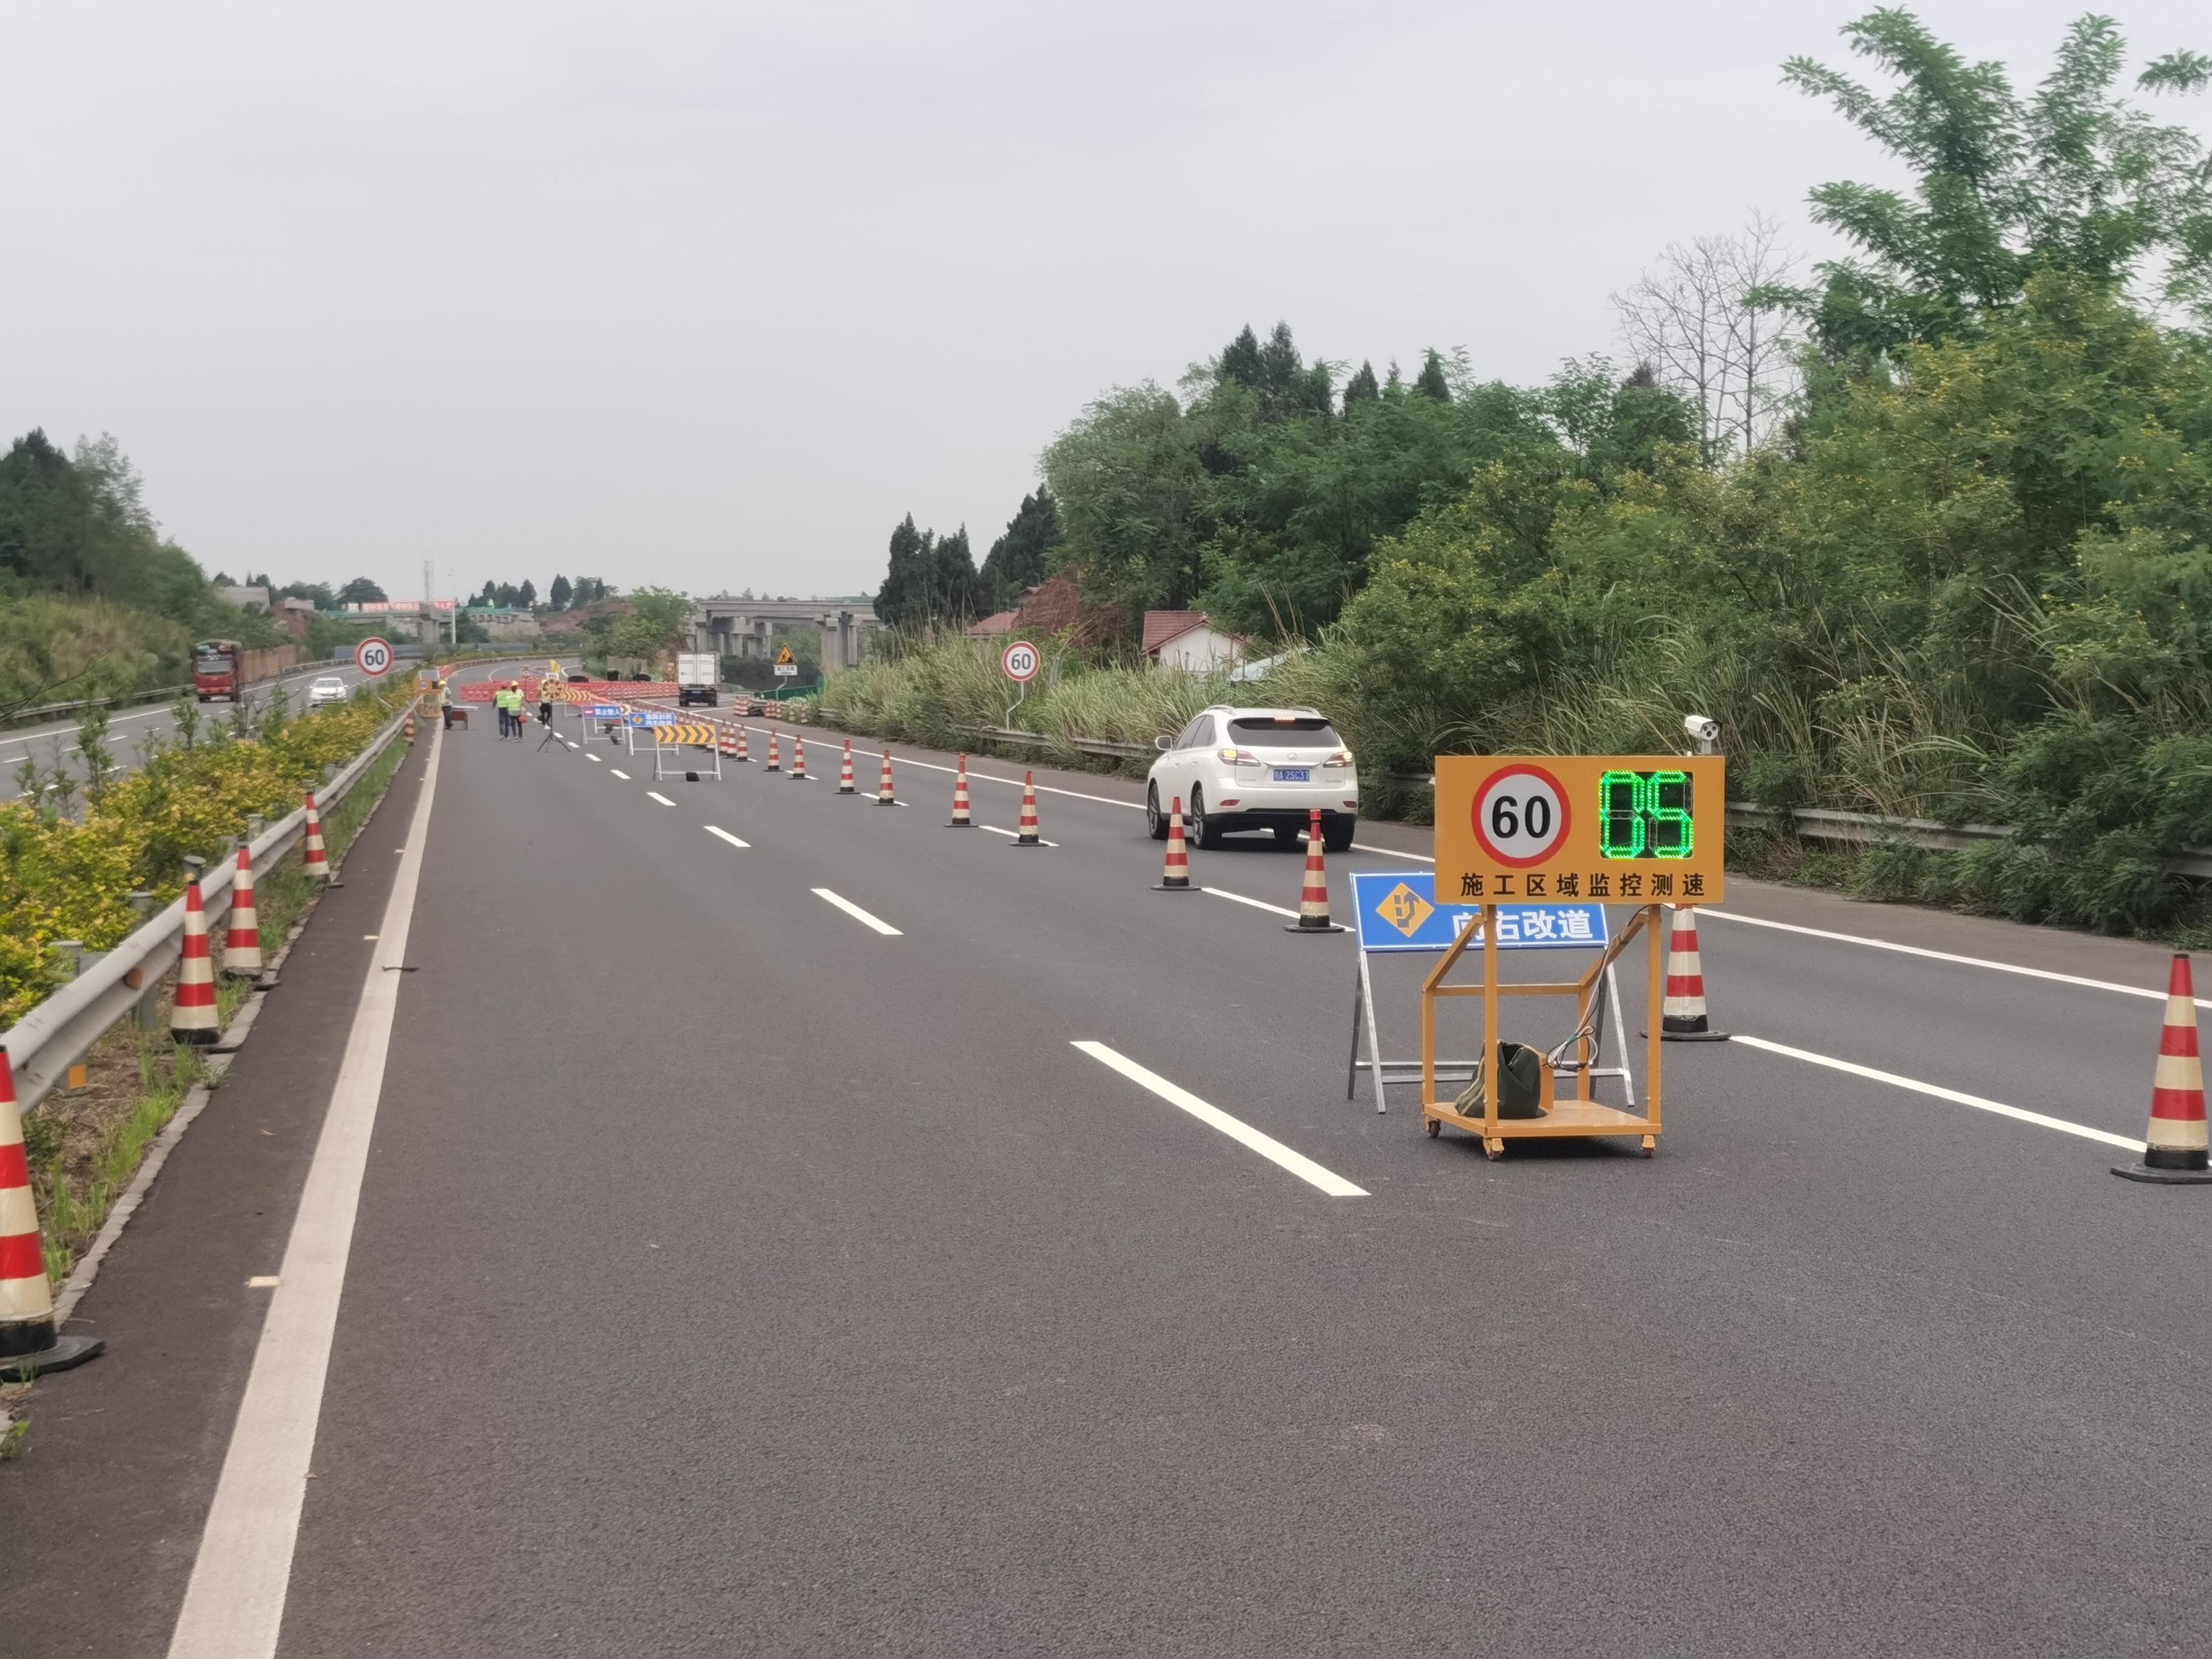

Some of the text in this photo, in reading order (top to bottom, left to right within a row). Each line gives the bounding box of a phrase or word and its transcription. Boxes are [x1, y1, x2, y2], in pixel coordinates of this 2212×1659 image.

[364, 649, 385, 666] 60
[1011, 653, 1031, 670] 60
[1492, 795, 1551, 839] 60
[1598, 769, 1694, 860] 05
[1460, 872, 1705, 897] 施工区域监控测速
